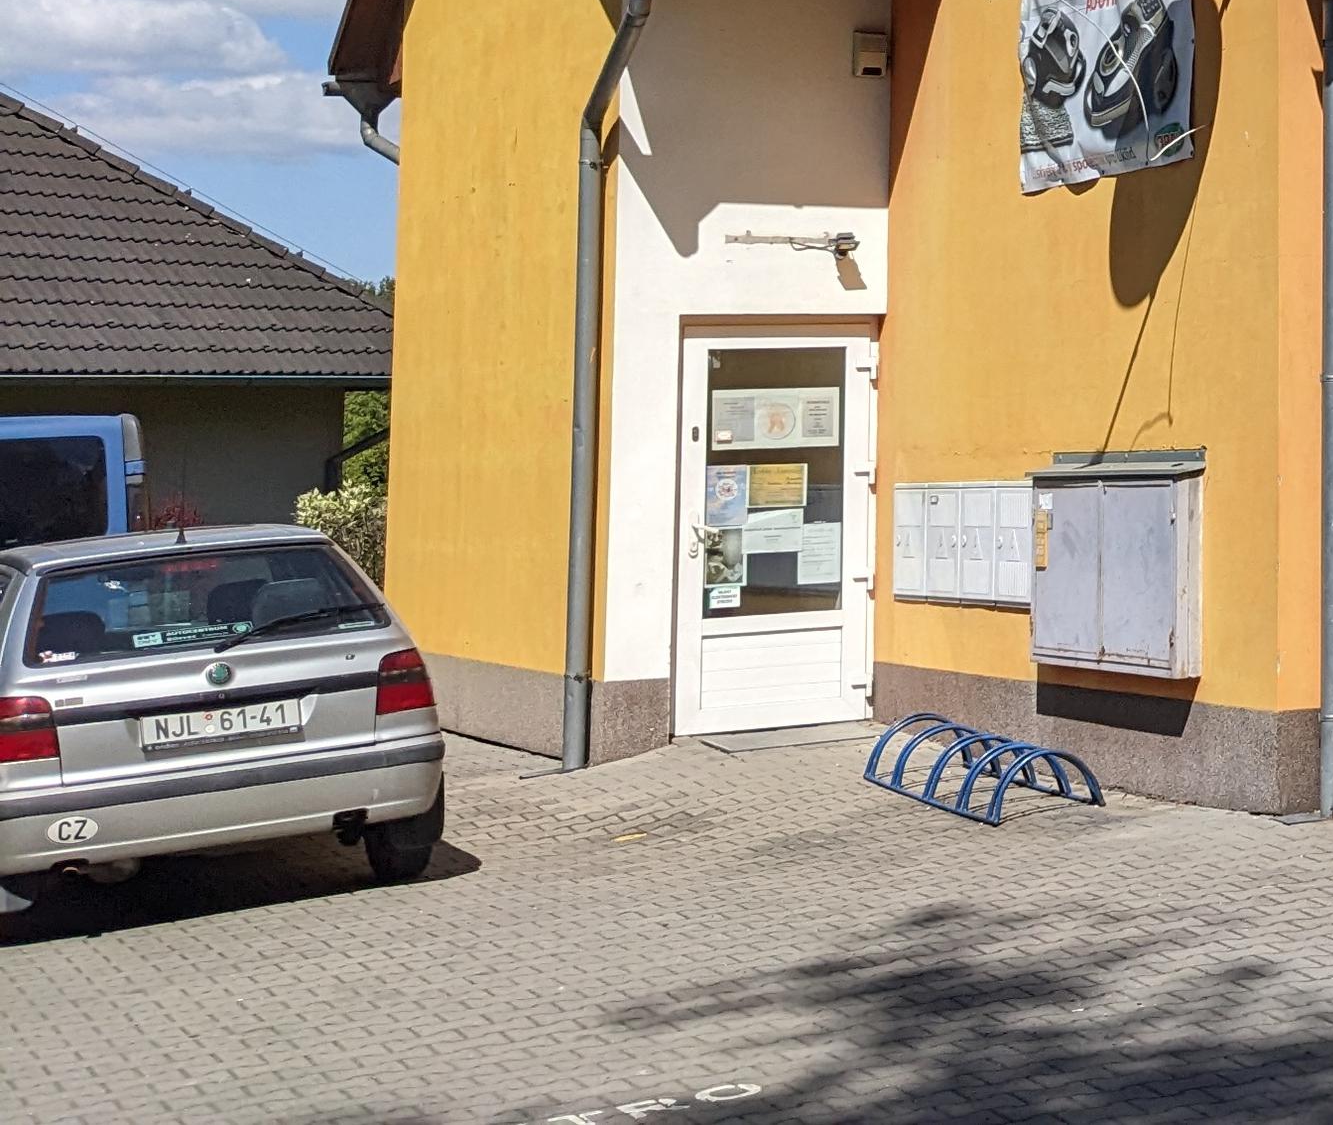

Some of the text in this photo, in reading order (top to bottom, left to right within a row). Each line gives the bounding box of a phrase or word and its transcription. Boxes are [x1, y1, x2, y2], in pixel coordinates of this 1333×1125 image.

[154, 715, 199, 740] NJL
[220, 704, 286, 731] 61-41
[58, 819, 88, 841] CZ
